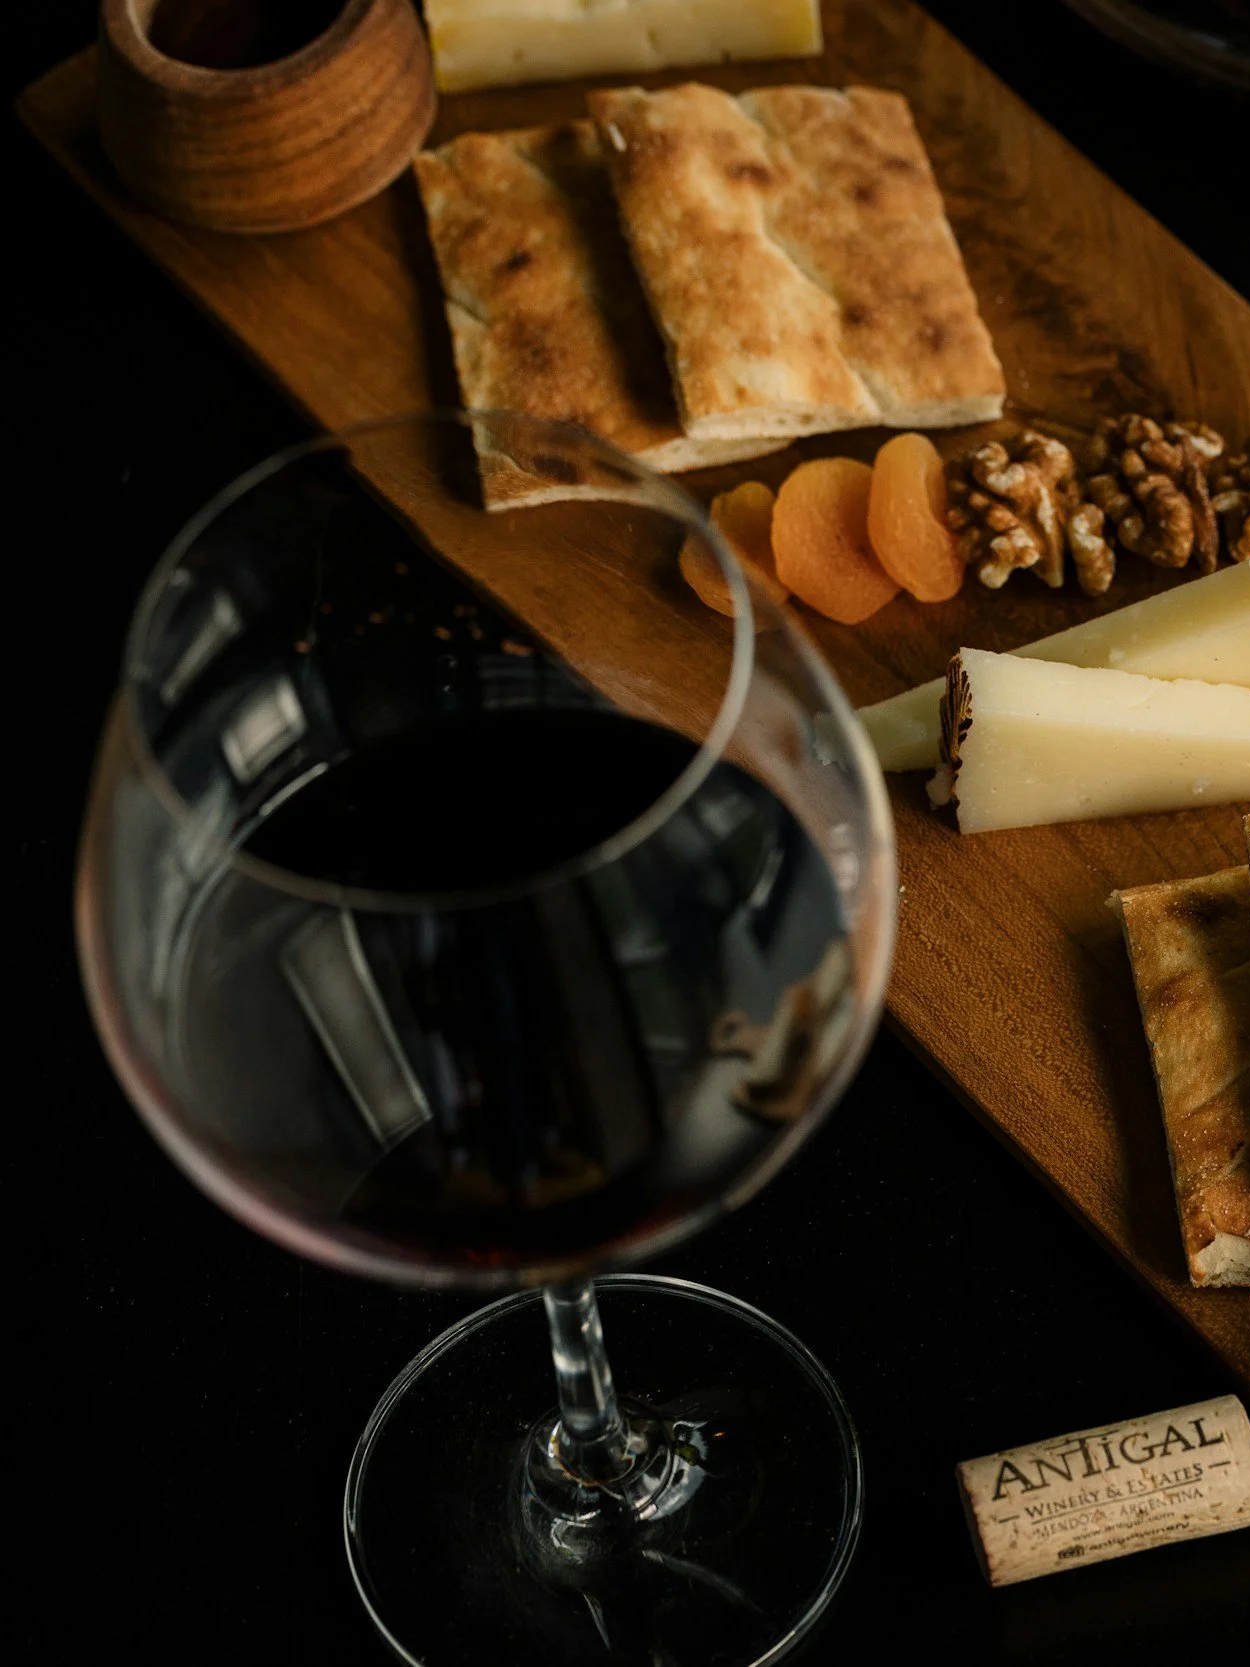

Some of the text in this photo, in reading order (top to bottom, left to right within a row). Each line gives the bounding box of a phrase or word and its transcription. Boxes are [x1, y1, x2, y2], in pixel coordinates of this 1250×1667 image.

[1025, 1463, 1204, 1518] WINERY & ESTATES
[1119, 1487, 1204, 1518] ARGENTINA
